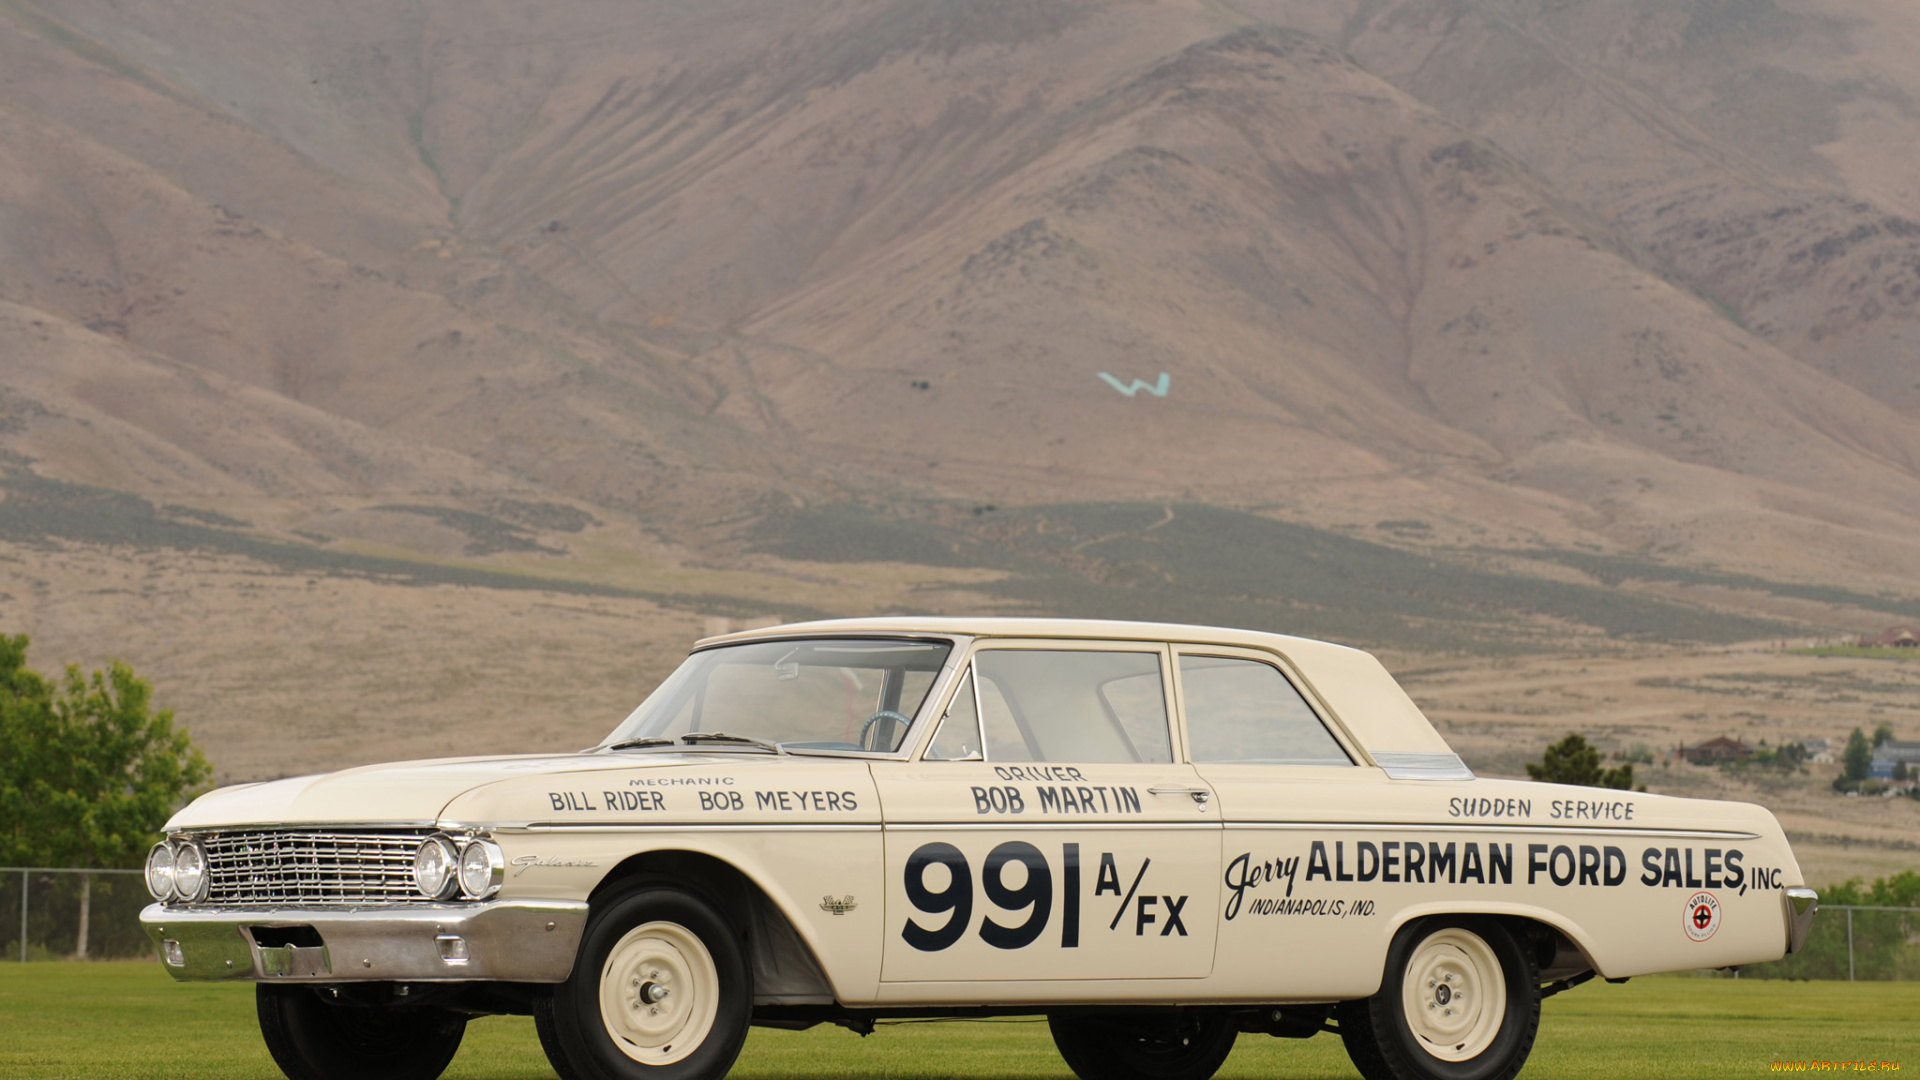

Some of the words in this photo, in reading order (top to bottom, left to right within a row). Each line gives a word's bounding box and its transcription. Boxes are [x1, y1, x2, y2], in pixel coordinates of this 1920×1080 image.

[629, 777, 734, 786] MECHANIC
[994, 766, 1088, 782] DRIVER
[548, 791, 597, 811] BILL
[603, 791, 666, 811] RIDER
[698, 791, 744, 811] BOB
[755, 791, 857, 811] MEYERS
[970, 786, 1025, 814] BOB
[1036, 786, 1142, 814] MARTIN
[1448, 797, 1531, 818] SUDDEN
[1550, 800, 1634, 820] SERVICE
[1224, 852, 1299, 921] Jerry
[1305, 841, 1513, 884] ALDERMAN
[1528, 844, 1626, 887] FORD
[1640, 847, 1747, 896] SALES,
[1752, 867, 1784, 889] INC.
[901, 840, 1081, 952] 991
[1689, 895, 1717, 910] AUTOLITE
[1349, 900, 1376, 916] IND.
